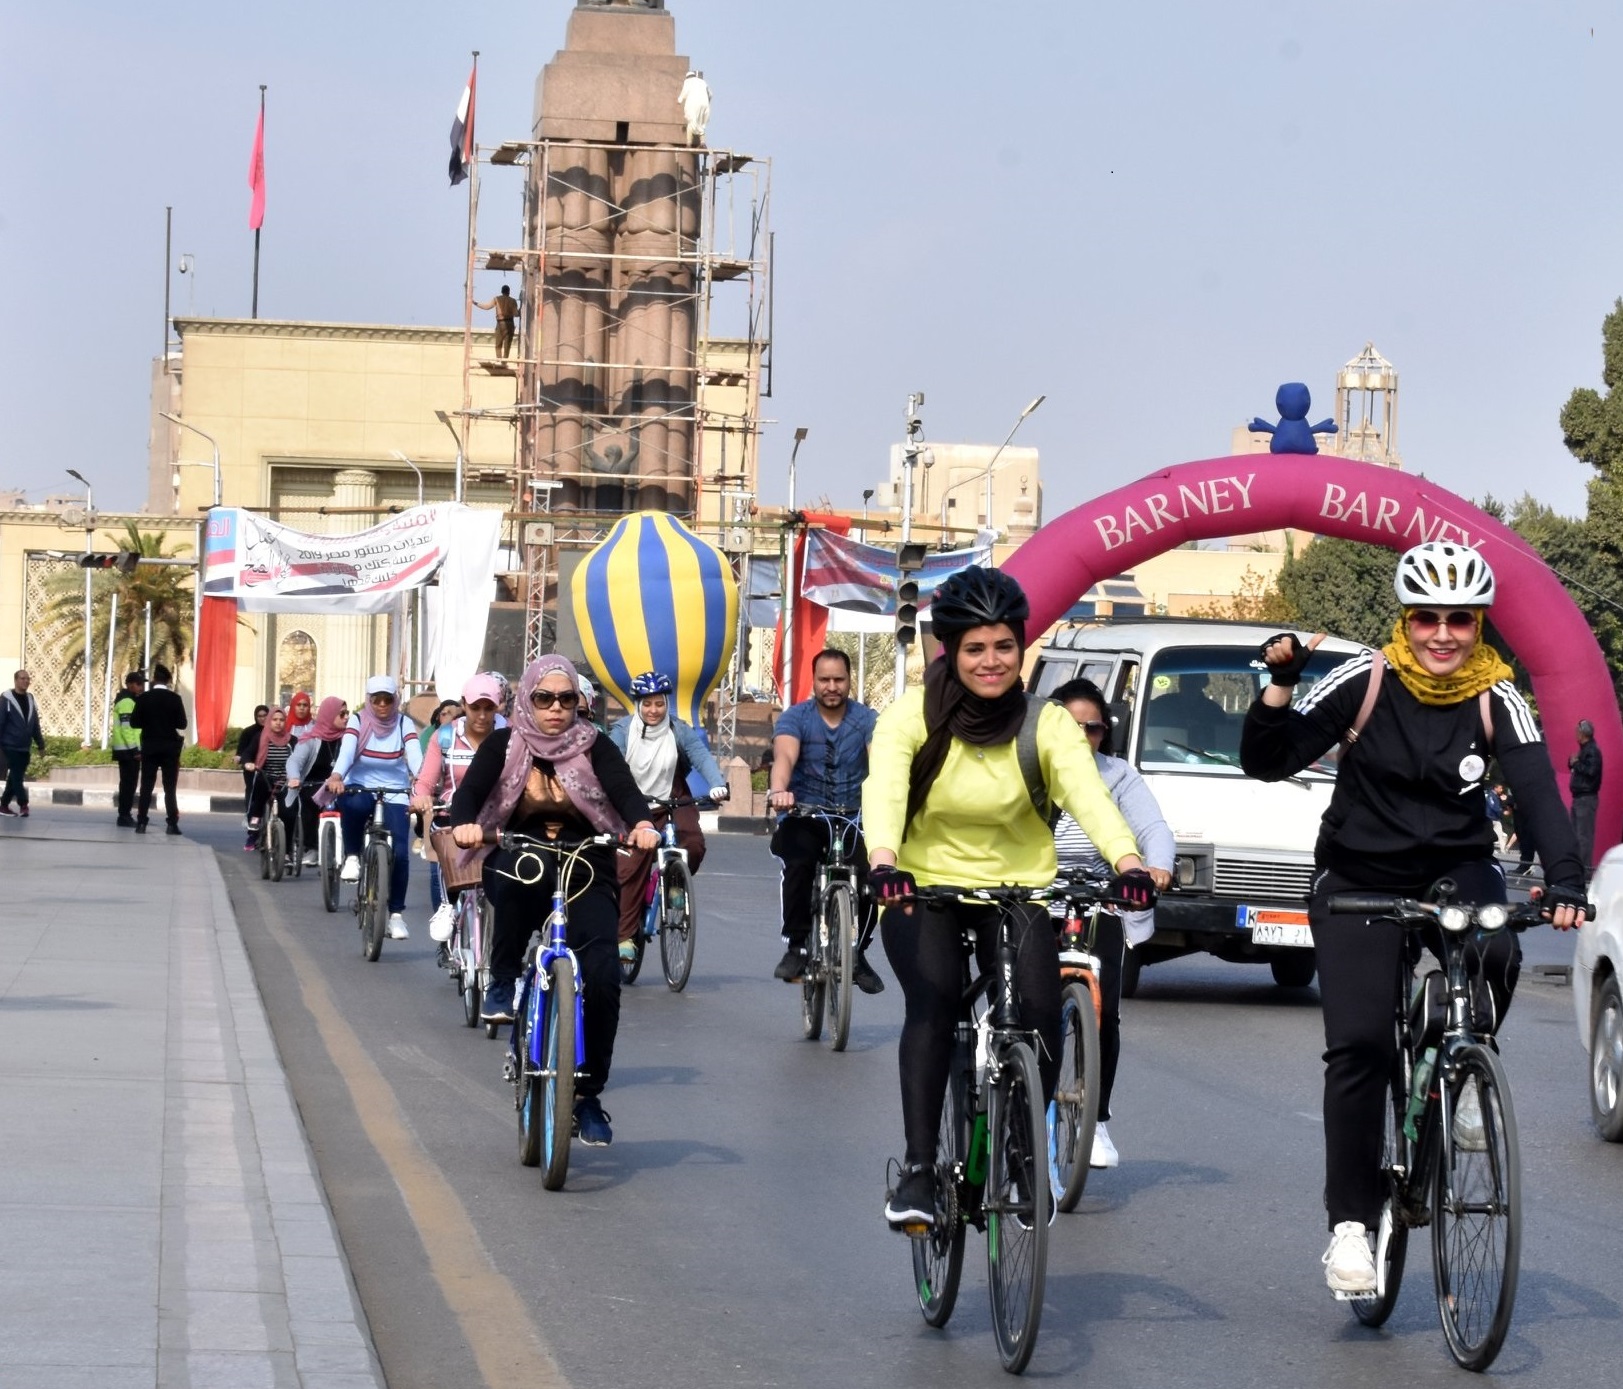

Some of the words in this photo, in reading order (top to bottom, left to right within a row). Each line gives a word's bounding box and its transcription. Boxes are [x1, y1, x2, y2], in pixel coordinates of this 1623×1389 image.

[1093, 473, 1256, 551] BARNEY
[297, 549, 322, 560] 2019
[325, 550, 351, 561] مصر
[354, 544, 391, 559] دستور
